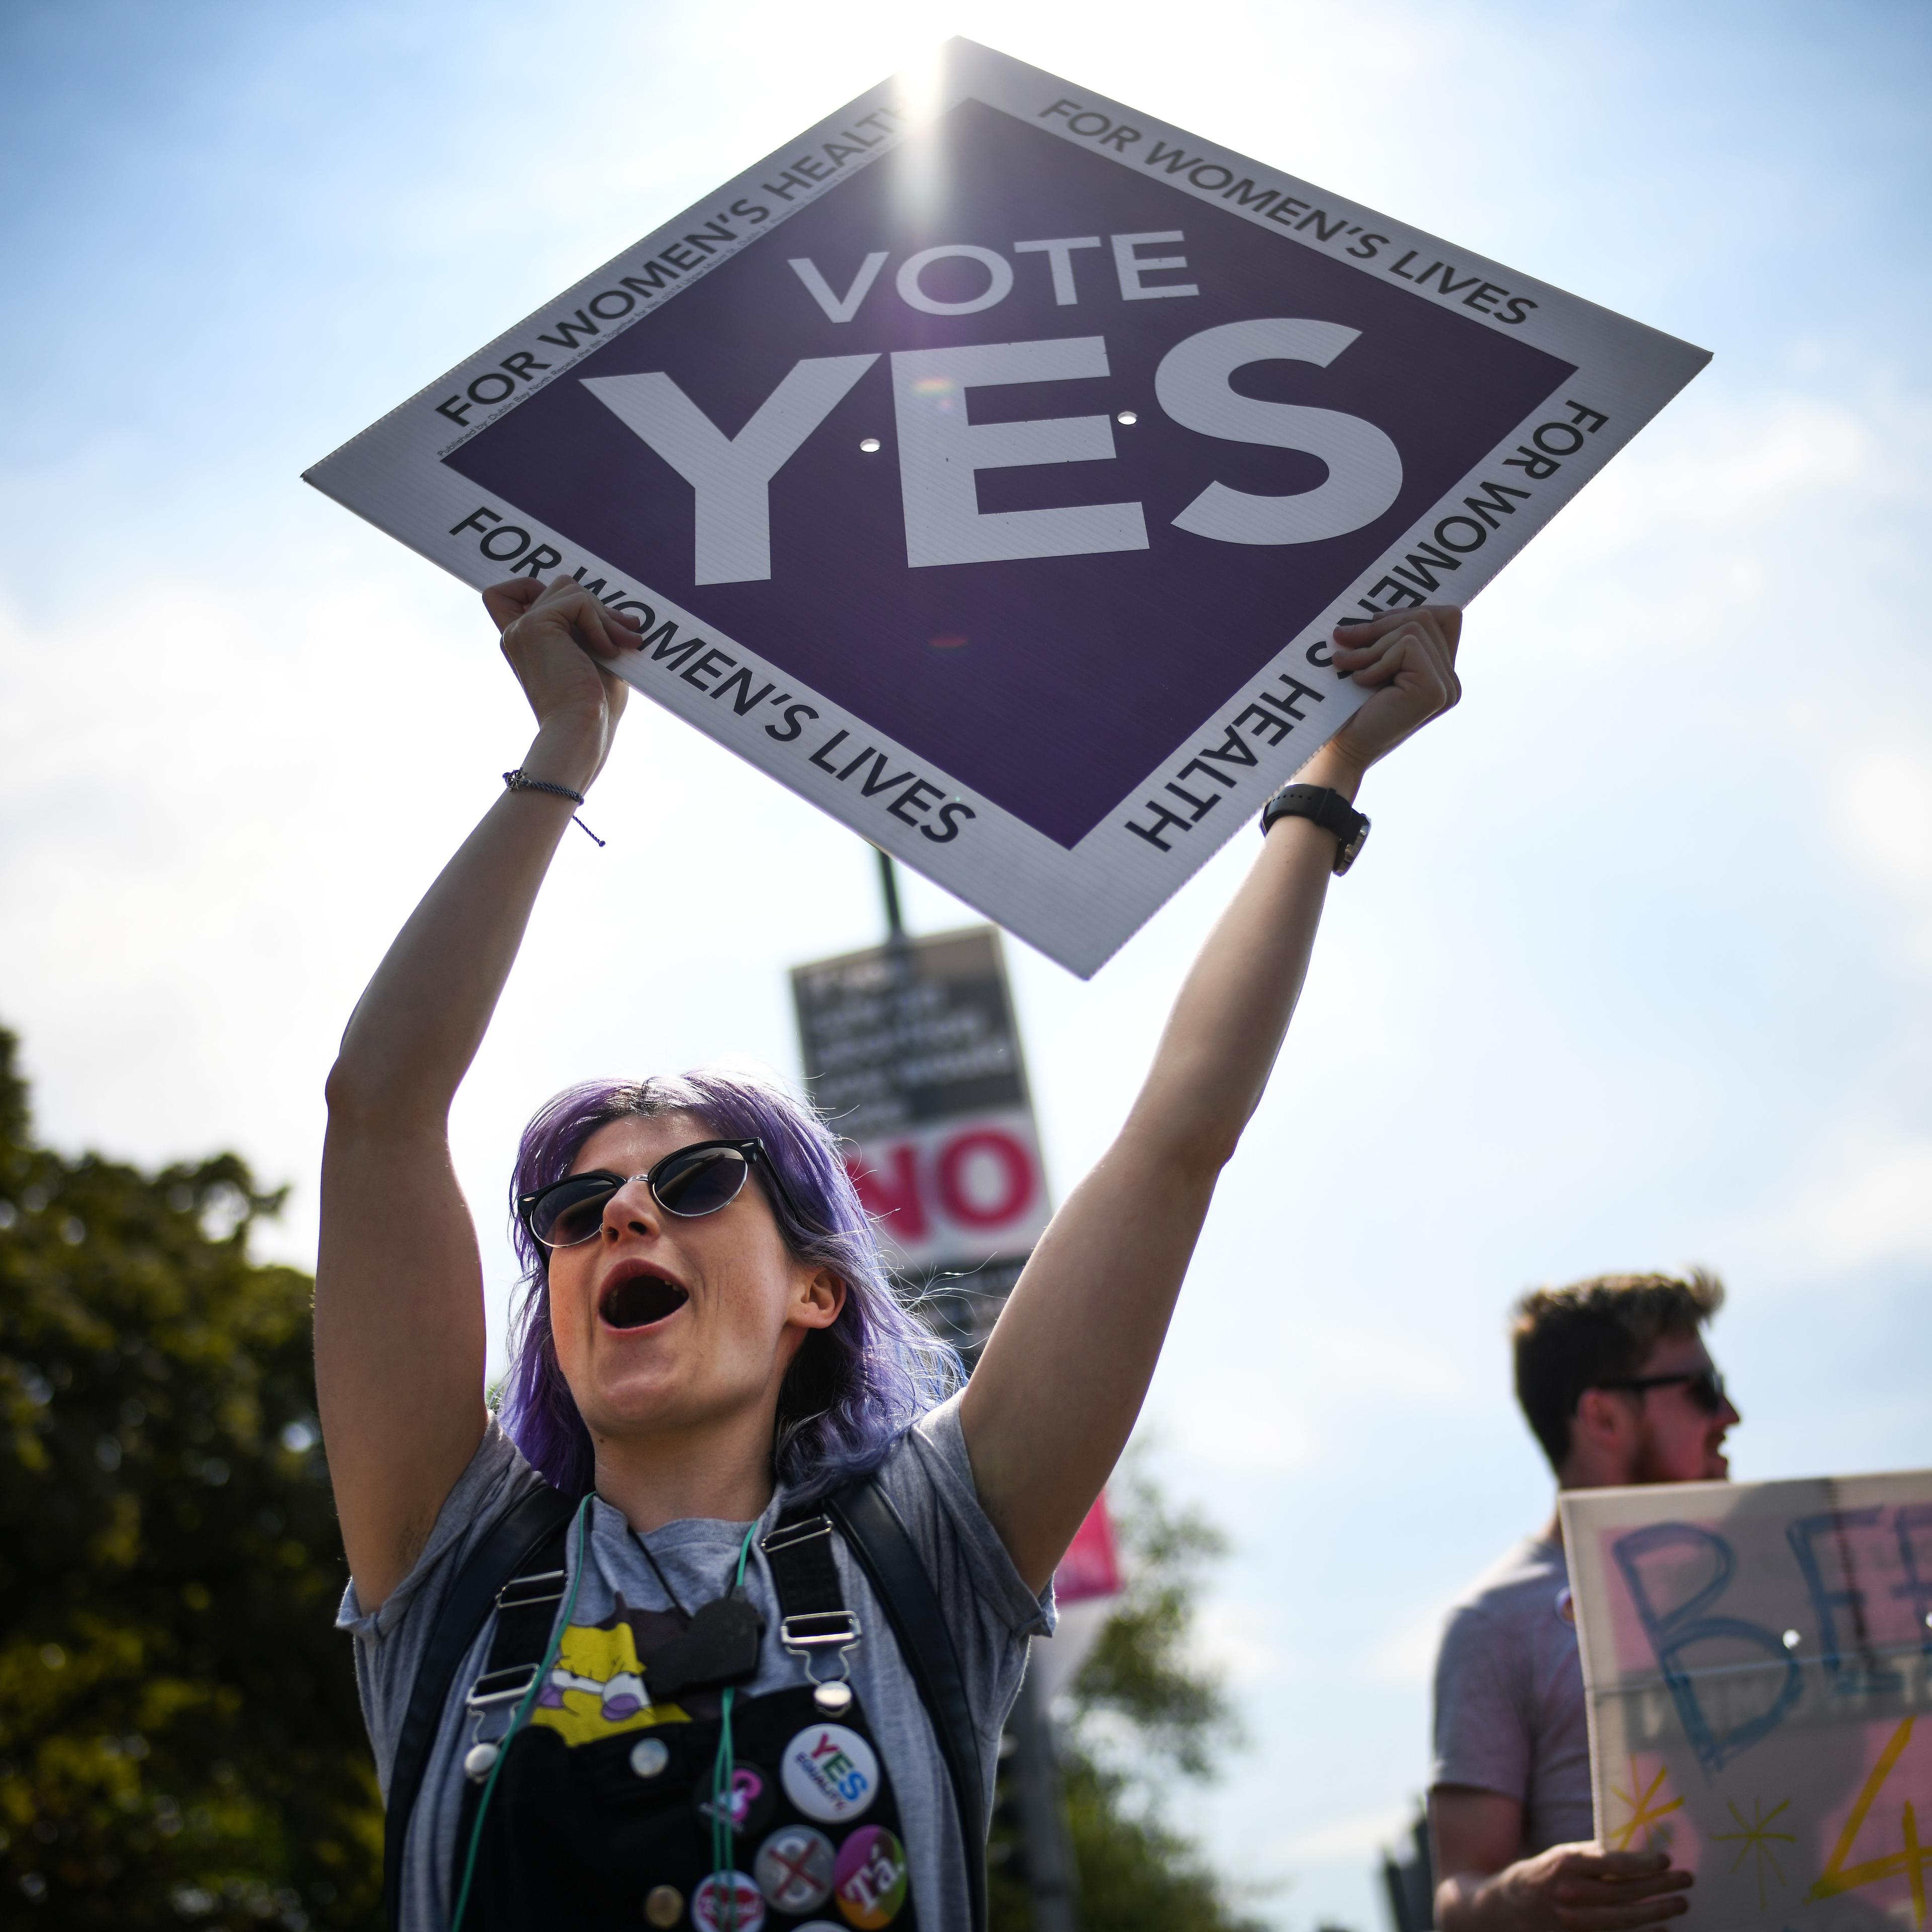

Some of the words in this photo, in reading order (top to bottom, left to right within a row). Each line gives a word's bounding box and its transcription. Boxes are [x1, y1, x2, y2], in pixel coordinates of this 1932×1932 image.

[787, 230, 1199, 323] VOTE
[1038, 99, 1142, 152] FOR
[1144, 141, 1390, 259] WOMEN'S
[1389, 250, 1539, 325] LIVES
[435, 351, 552, 428] FOR
[537, 198, 770, 349] WOMEN'S
[437, 428, 476, 456] Published
[488, 403, 515, 421] Dublin
[514, 391, 530, 403] Bay
[528, 376, 551, 391] North
[551, 357, 577, 376] Repeal
[577, 348, 591, 358] the
[590, 340, 602, 349] 8th
[602, 317, 636, 339] Together
[634, 309, 647, 317] for
[578, 318, 1403, 585] YES
[1502, 400, 1608, 479] FOR
[449, 507, 562, 578] FOR
[808, 729, 976, 843] LIVES
[1124, 674, 1325, 852] HEALTH
[848, 1129, 1036, 1240] NO
[794, 1751, 846, 1811] EQUALITY
[811, 1732, 868, 1802] YES
[1804, 1715, 1932, 1931] 4
